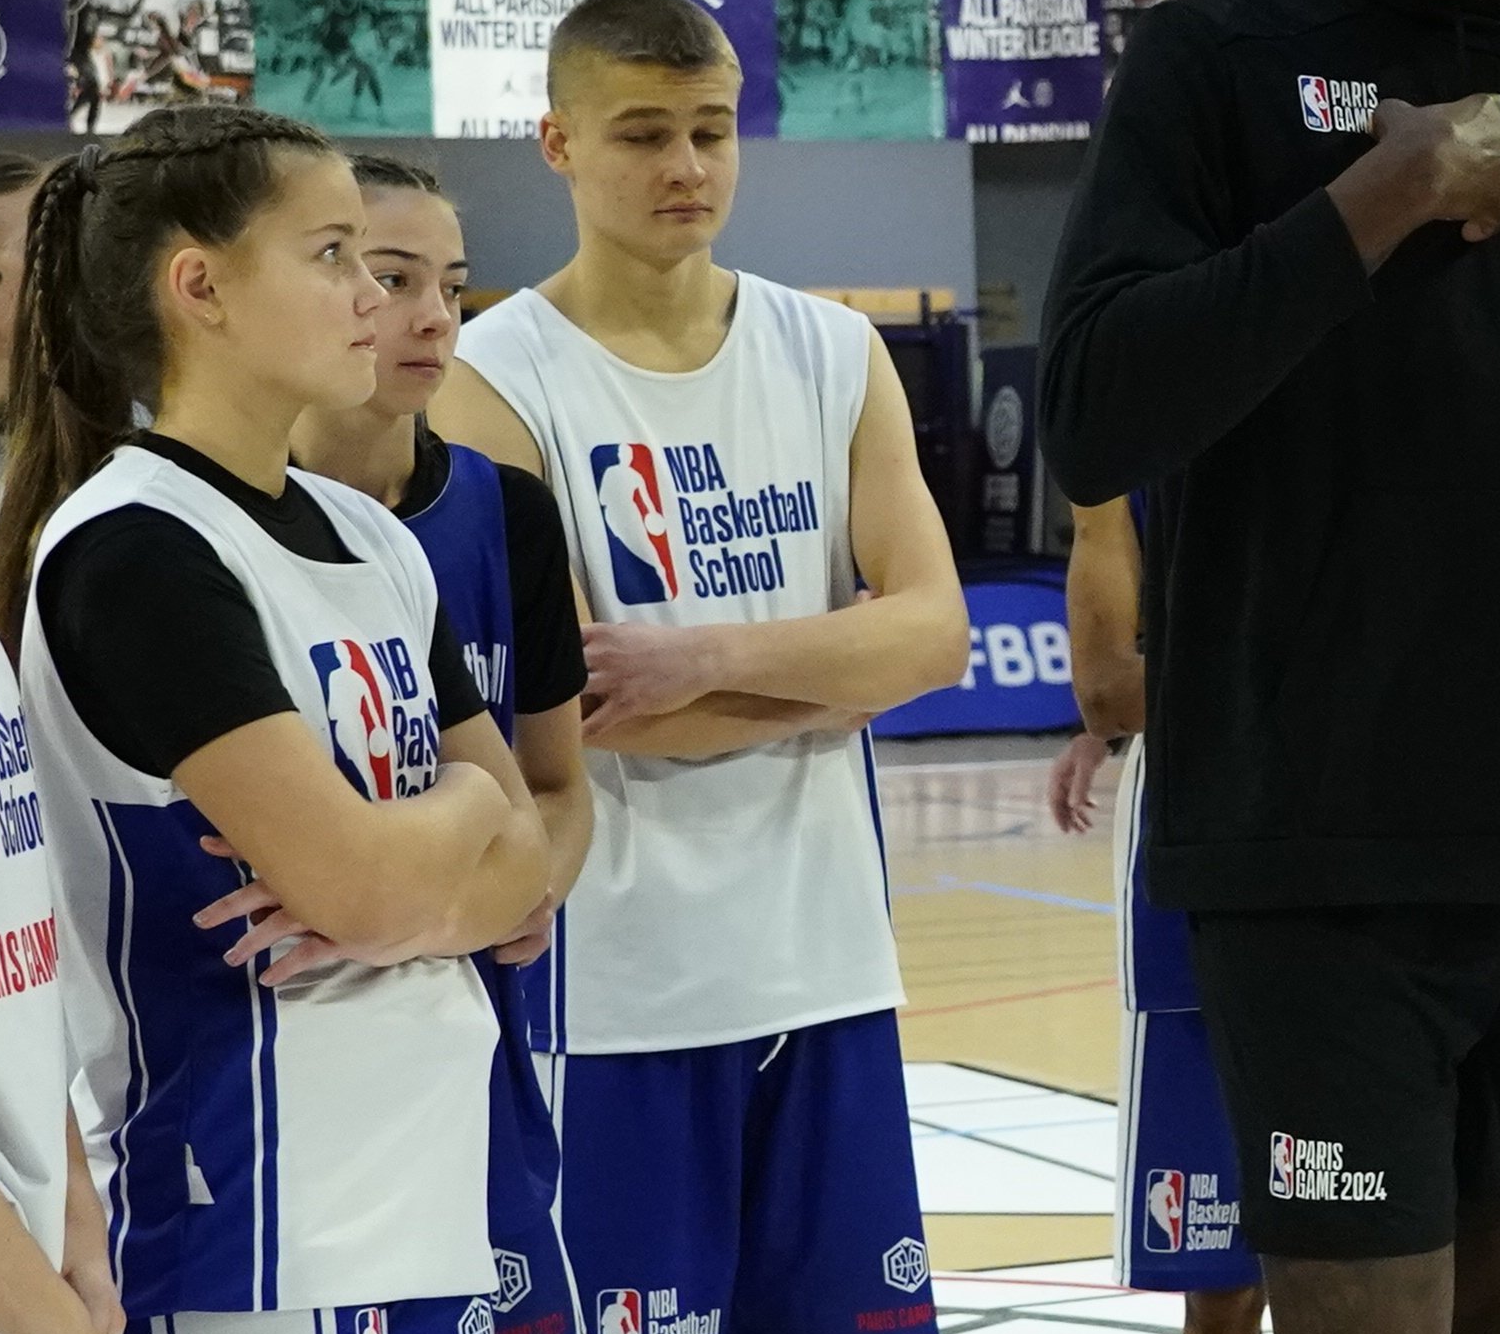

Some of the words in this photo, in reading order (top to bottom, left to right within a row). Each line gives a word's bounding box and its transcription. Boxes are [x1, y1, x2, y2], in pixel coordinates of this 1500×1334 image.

[441, 20, 518, 49] WINTER
[1329, 79, 1378, 109] PARIS
[664, 443, 727, 494] NBA
[678, 481, 819, 545] Basketball
[689, 538, 785, 598] School
[1296, 1139, 1344, 1172] PARIS
[1189, 1173, 1218, 1199] NBA
[1296, 1169, 1339, 1201] GAME
[1341, 1171, 1388, 1201] 2024
[1186, 1226, 1233, 1251] School
[648, 1287, 678, 1319] NBA
